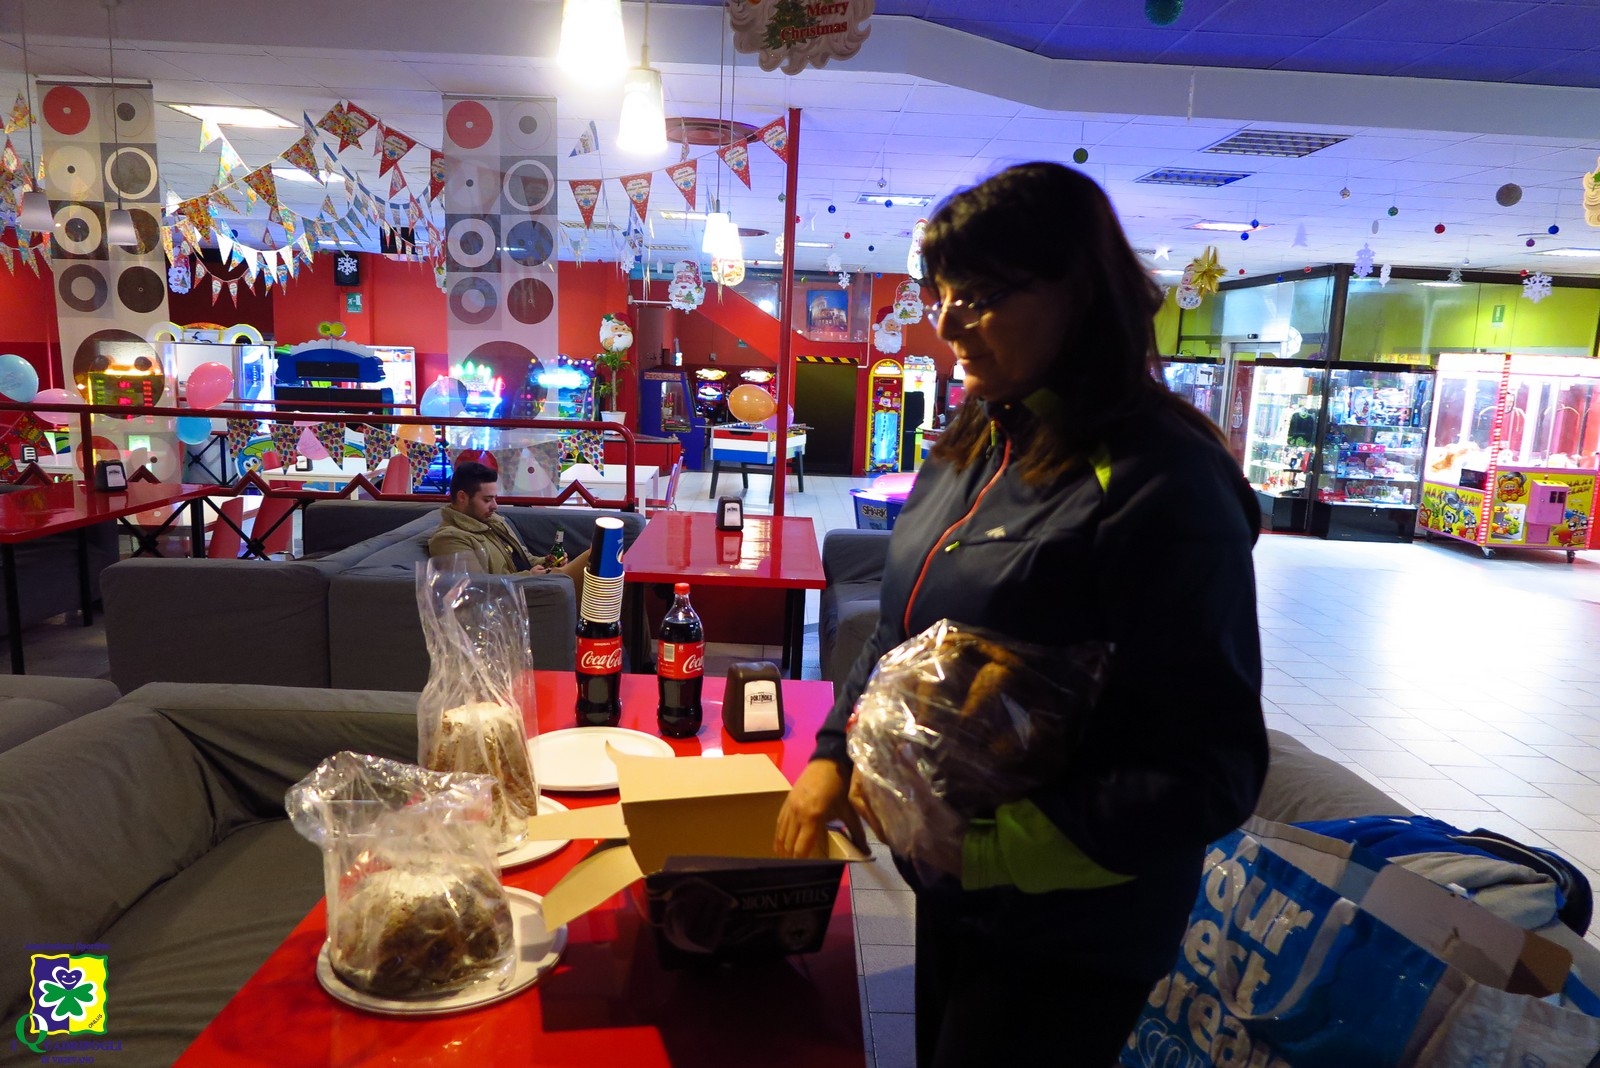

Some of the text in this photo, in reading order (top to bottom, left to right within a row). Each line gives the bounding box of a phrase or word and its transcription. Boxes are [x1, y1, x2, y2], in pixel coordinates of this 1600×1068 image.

[805, 1, 850, 18] Merry
[780, 21, 848, 41] Christmas
[741, 887, 830, 912] STELLA NOIR
